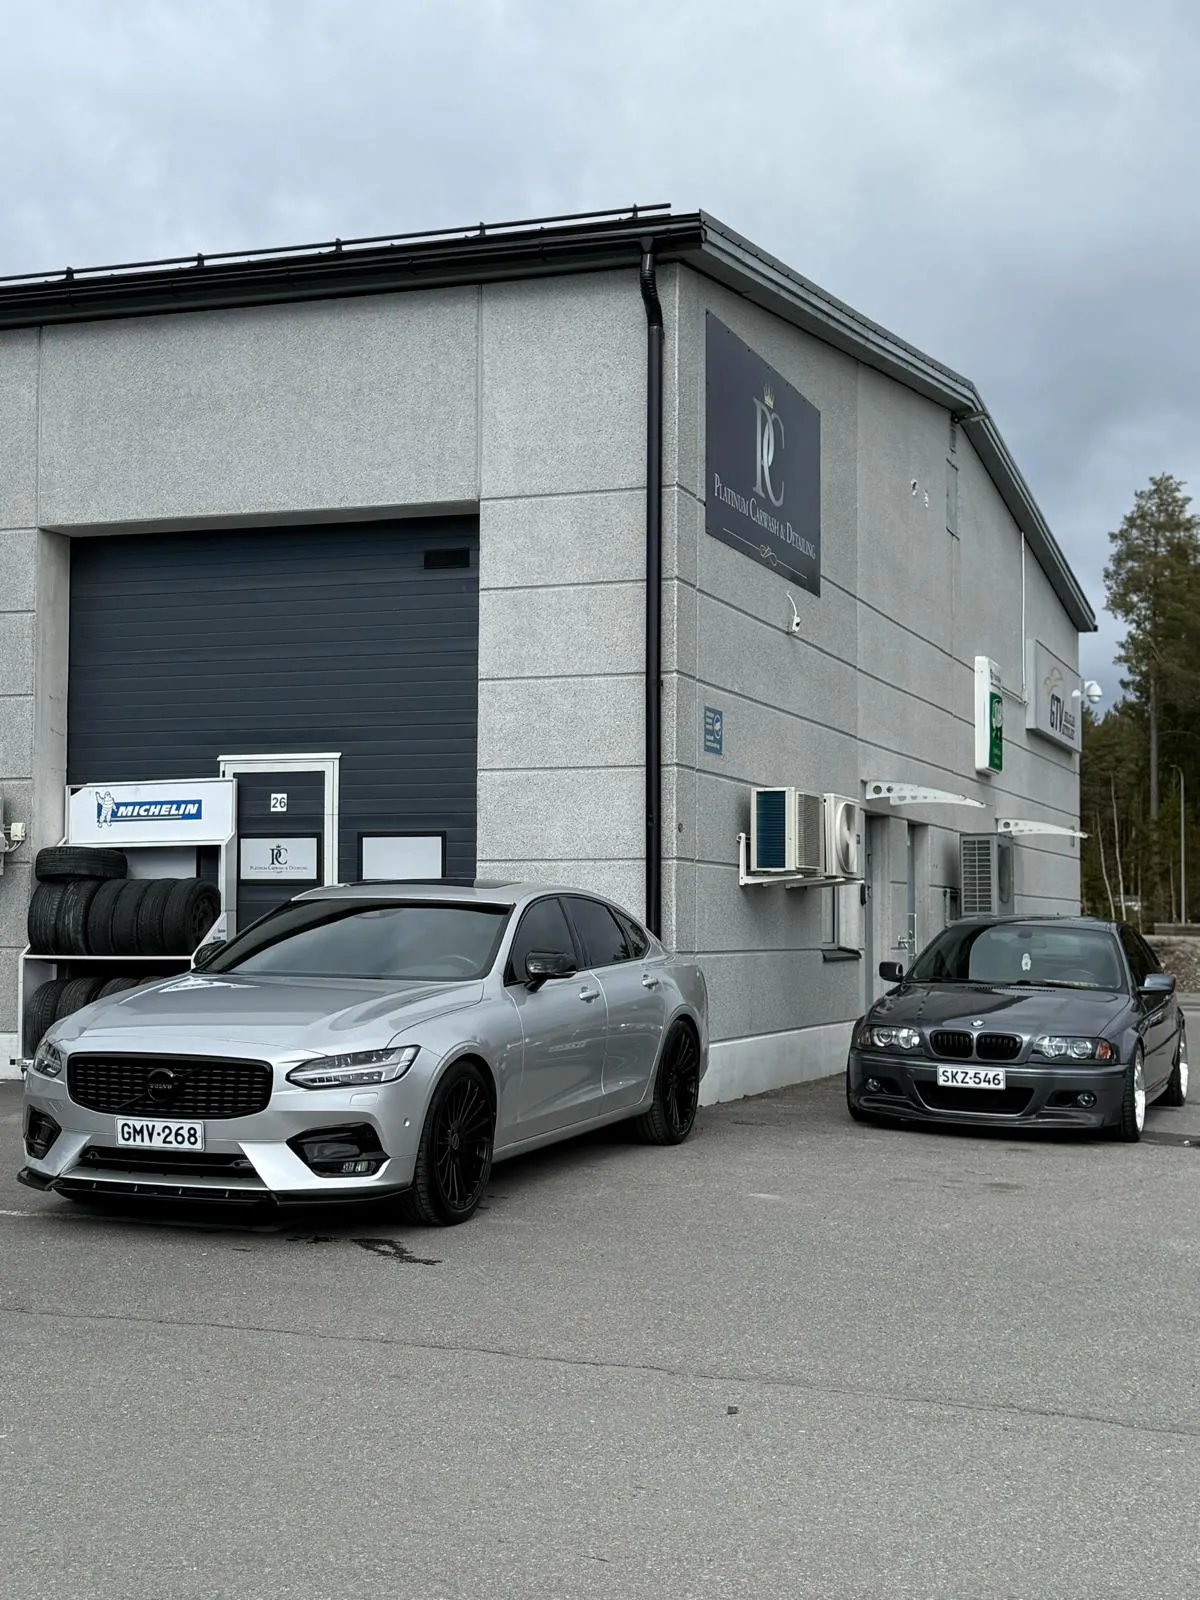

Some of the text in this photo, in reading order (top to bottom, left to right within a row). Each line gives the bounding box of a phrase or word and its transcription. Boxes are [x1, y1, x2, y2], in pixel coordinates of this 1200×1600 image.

[714, 472, 749, 517] PLATINUM
[117, 804, 199, 817] MICHELIN
[271, 796, 287, 809] 26
[941, 1069, 1002, 1087] SKZ-546
[120, 1122, 199, 1146] GMV-268
